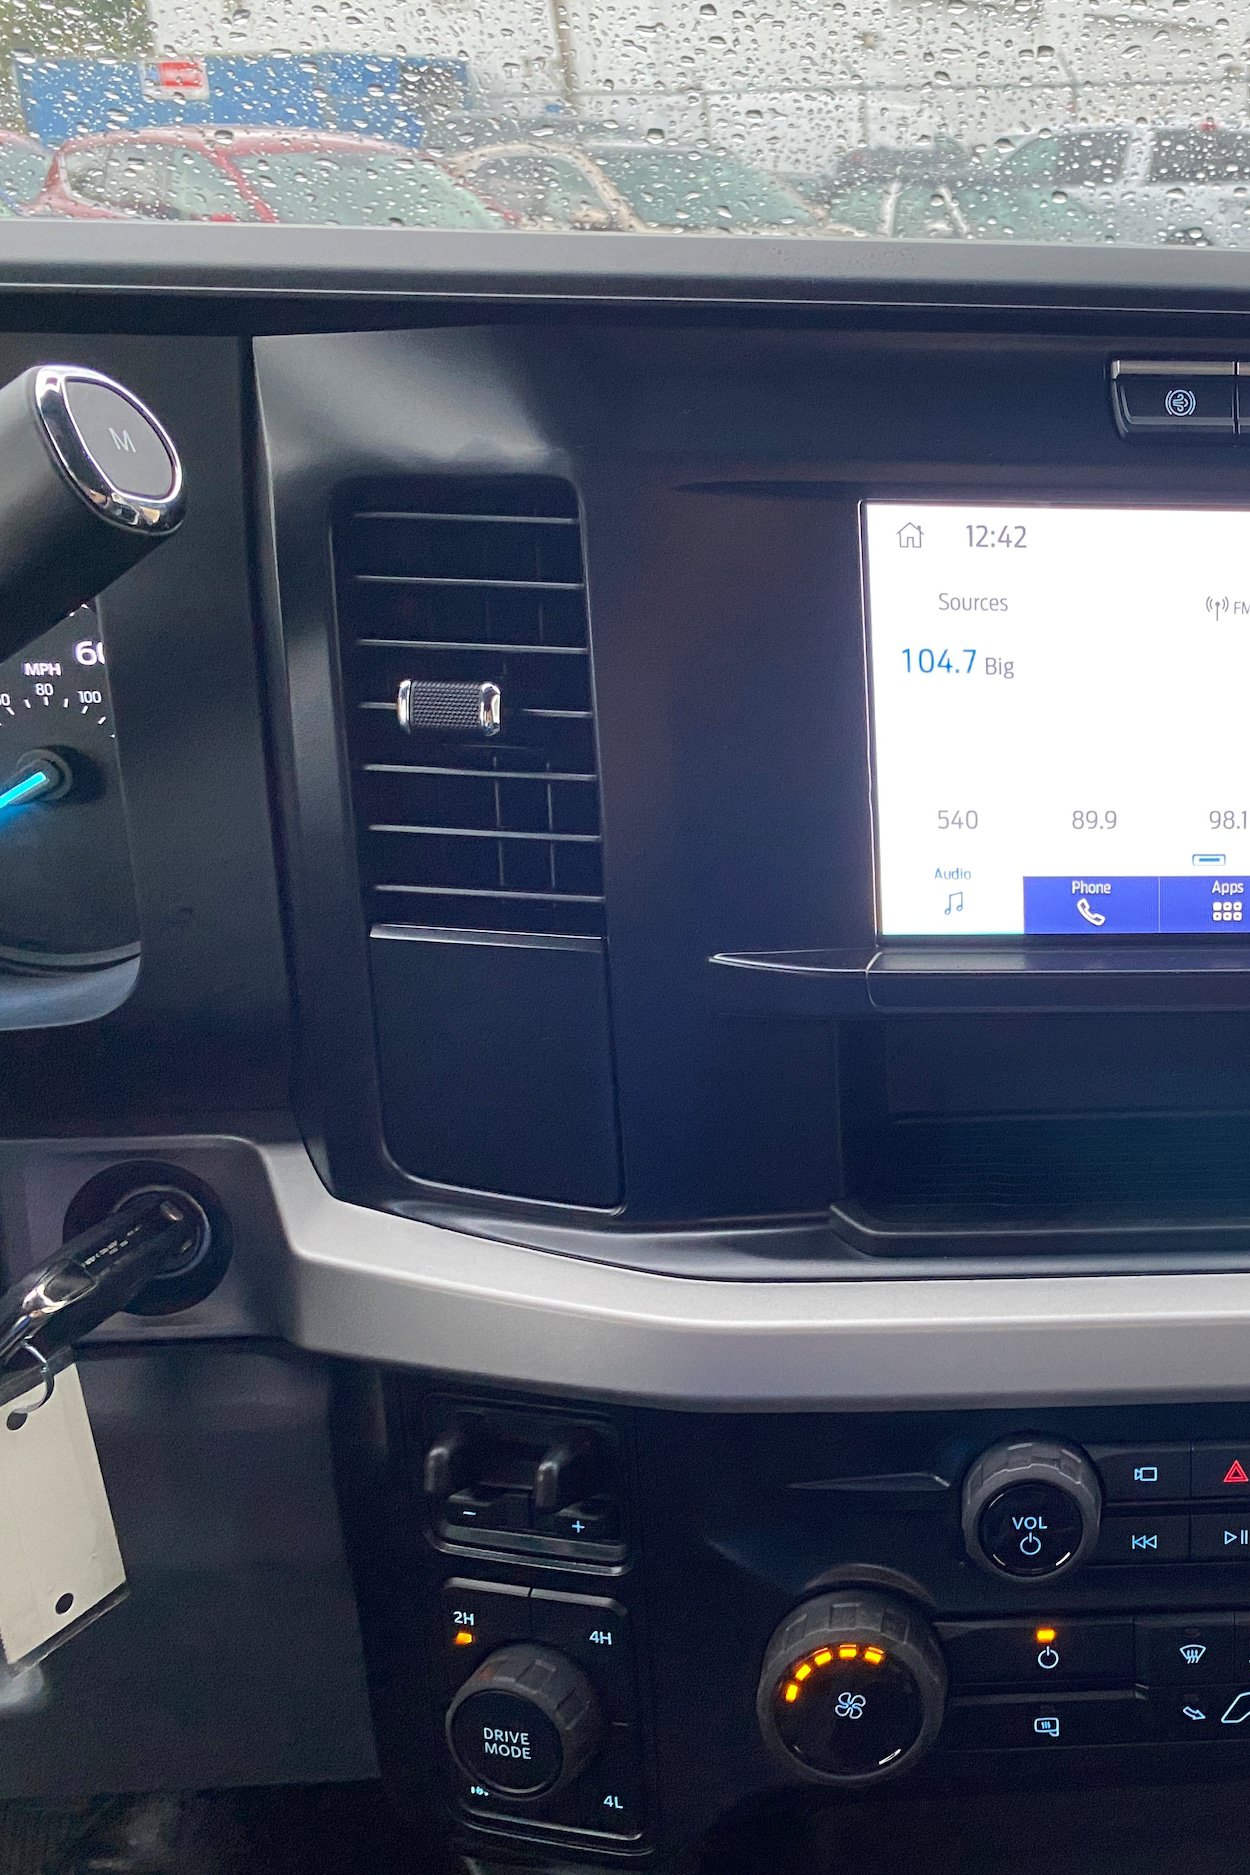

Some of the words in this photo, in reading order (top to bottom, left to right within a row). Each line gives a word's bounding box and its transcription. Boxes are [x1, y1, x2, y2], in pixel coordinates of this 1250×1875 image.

[108, 427, 137, 453] M
[965, 524, 1028, 549] 12:42
[938, 592, 1009, 612] Sources
[24, 662, 62, 676] MPH
[902, 648, 977, 674] 104.7
[985, 657, 1015, 680] Big
[35, 682, 54, 696] 80
[77, 690, 102, 704] 100
[0, 693, 11, 707] 0
[938, 809, 979, 830] 540
[1071, 810, 1117, 830] 89.9
[1209, 810, 1247, 830] 98.1
[934, 867, 972, 880] Audio
[1071, 880, 1111, 895] Phone
[1211, 879, 1244, 896] Apps
[1012, 1516, 1048, 1531] VOL
[453, 1610, 475, 1626] 2H
[589, 1630, 612, 1646] 4H
[483, 1727, 530, 1745] DRIVE
[485, 1743, 531, 1760] MODE
[603, 1795, 624, 1810] 4L
